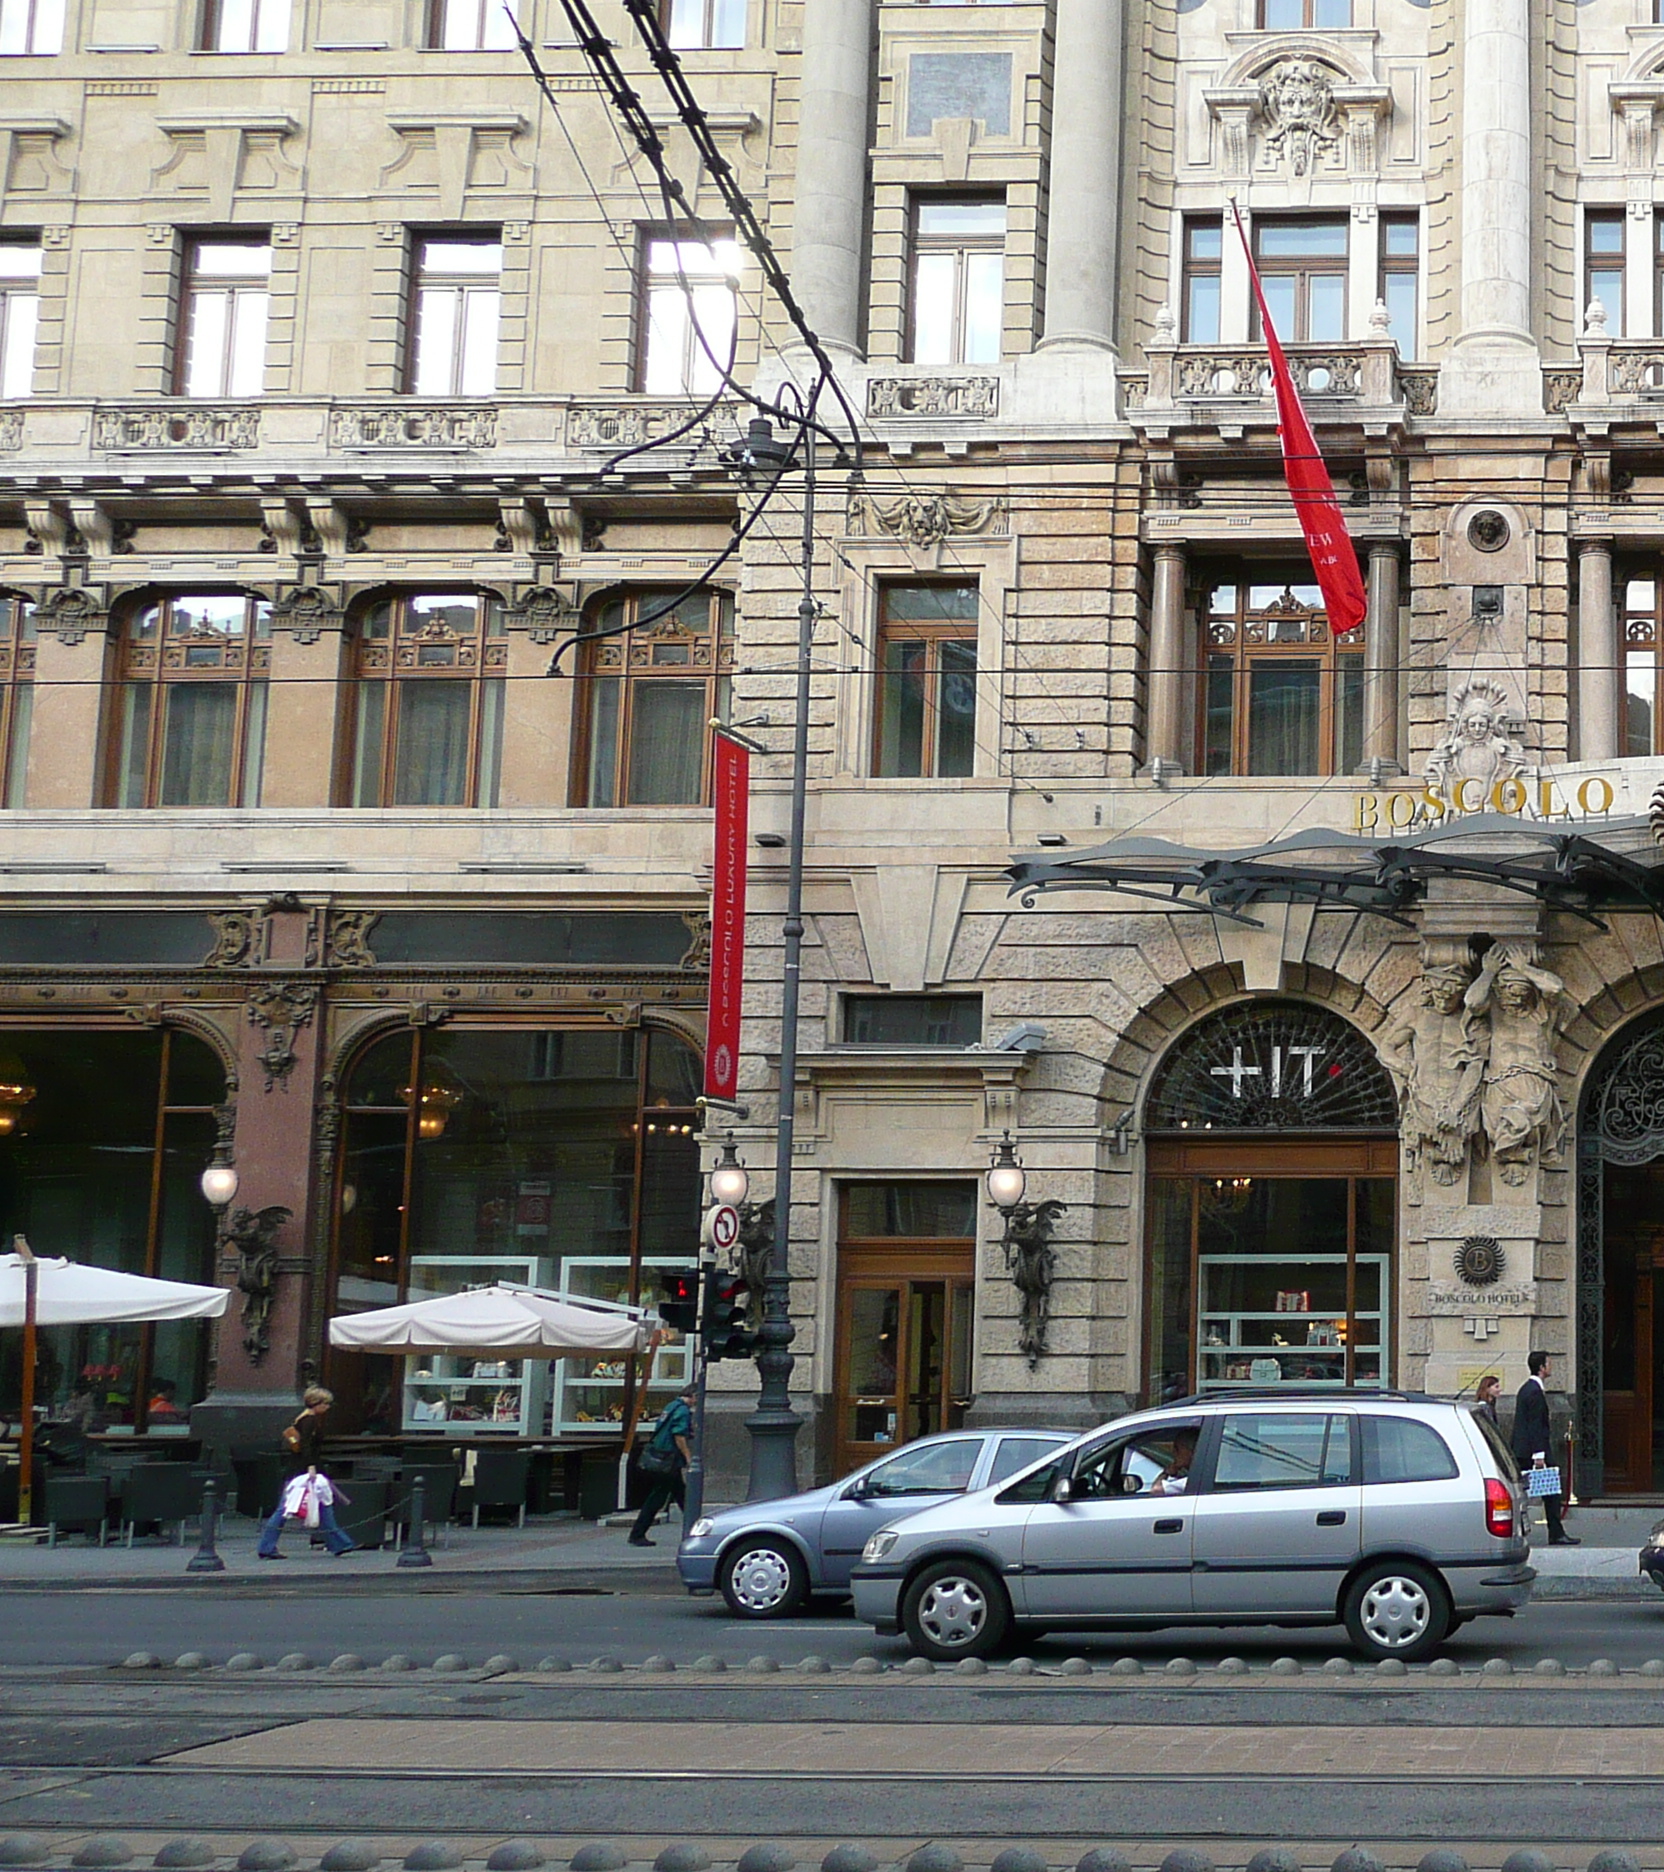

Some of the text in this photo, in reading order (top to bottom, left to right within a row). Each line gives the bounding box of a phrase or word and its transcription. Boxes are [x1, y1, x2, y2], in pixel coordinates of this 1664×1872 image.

[728, 754, 737, 819] HOTEL
[1351, 777, 1614, 830] BOSCOLO
[1435, 1293, 1529, 1304] BOSCOLO HOTELS
